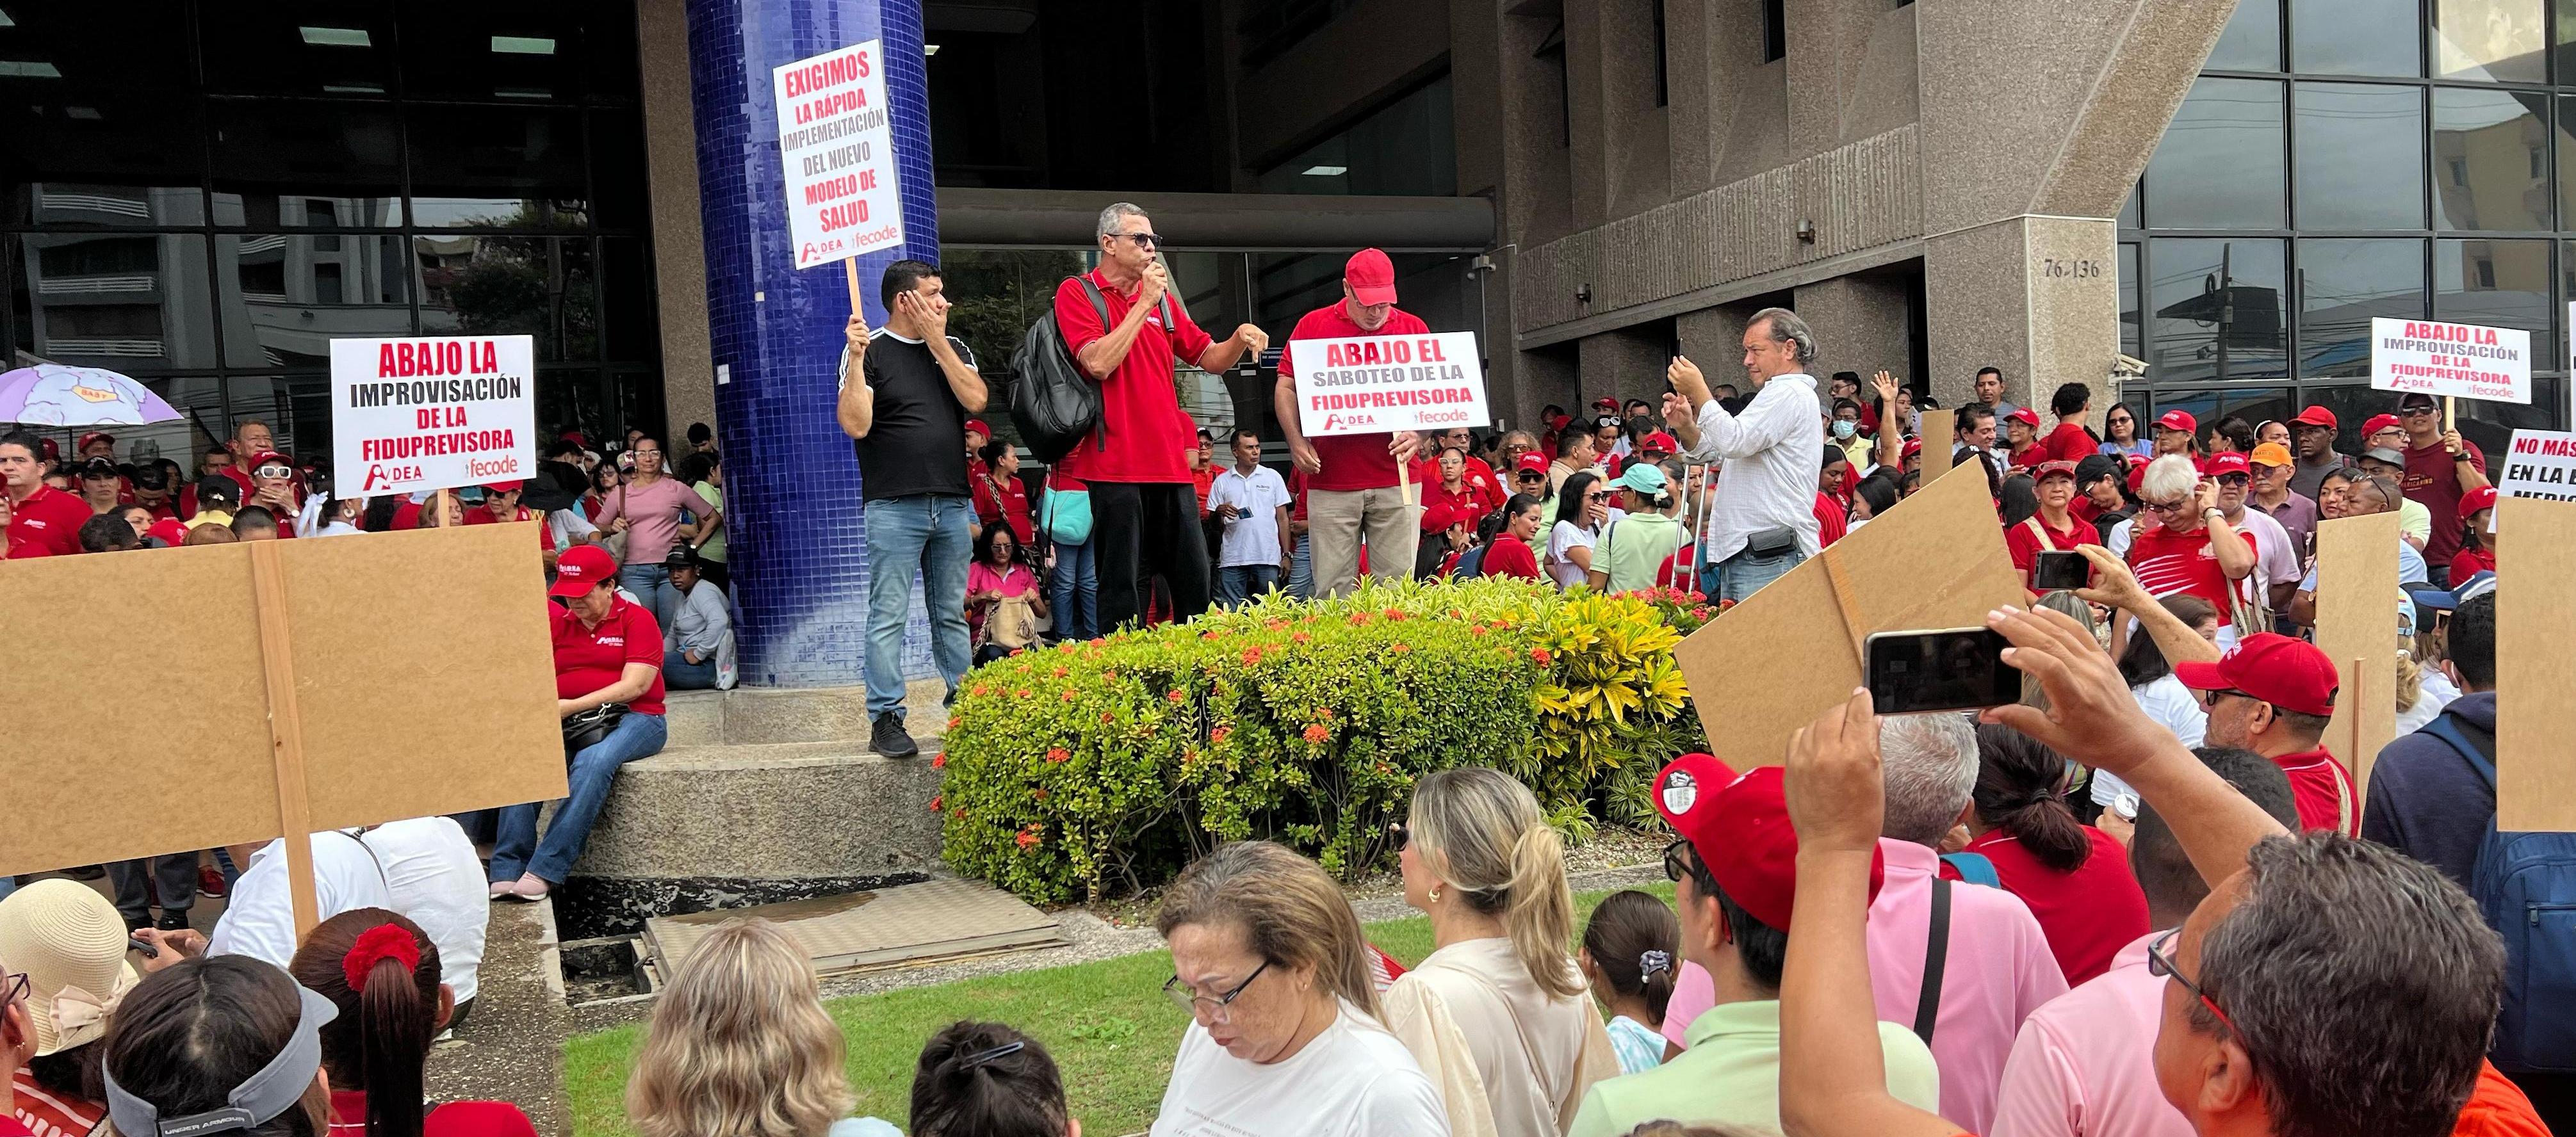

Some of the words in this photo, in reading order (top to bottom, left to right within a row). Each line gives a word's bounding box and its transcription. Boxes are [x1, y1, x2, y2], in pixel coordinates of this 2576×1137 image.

[785, 51, 870, 99] EXIGIMOS
[795, 103, 812, 125] LA
[814, 93, 867, 120] RÁPIDA
[783, 108, 884, 152] IMPLEMENTACIÓN
[803, 153, 826, 177] DEL
[828, 141, 870, 170] NUEVO
[805, 174, 857, 206] MODELO
[860, 169, 876, 191] DE
[820, 200, 869, 232] SALUD
[856, 225, 897, 248] fecode
[2044, 259, 2099, 277] 76-136
[2404, 322, 2468, 343] ABAJO
[2475, 328, 2498, 346] LA
[379, 341, 462, 378] ABAJO
[469, 341, 498, 374] LA
[1326, 340, 1411, 367] ABAJO
[1417, 339, 1446, 362] EL
[2384, 337, 2518, 360] IMPROVISACIÓN
[2431, 355, 2449, 366] DE
[2454, 357, 2471, 368] LA
[1313, 367, 1405, 387] SABOTEO
[1410, 366, 1436, 382] DE
[1441, 365, 1464, 380] LA
[2390, 364, 2511, 385] FIDUPREVISORA
[350, 373, 521, 408] IMPROVISACIÓN
[1311, 387, 1473, 411] FIDUPREVISORA
[2472, 385, 2514, 398] fecode
[417, 408, 441, 430] DE
[446, 407, 467, 427] LA
[1419, 409, 1469, 424] fecode
[363, 429, 514, 462] FIDUPREVISORA
[2515, 438, 2539, 455] NO
[2541, 438, 2576, 457] MÁS
[471, 455, 518, 478] fecode
[2508, 464, 2534, 481] EN
[2538, 466, 2563, 483] LA
[165, 1124, 200, 1134] UNDER
[202, 1117, 245, 1128] ARMOUR
